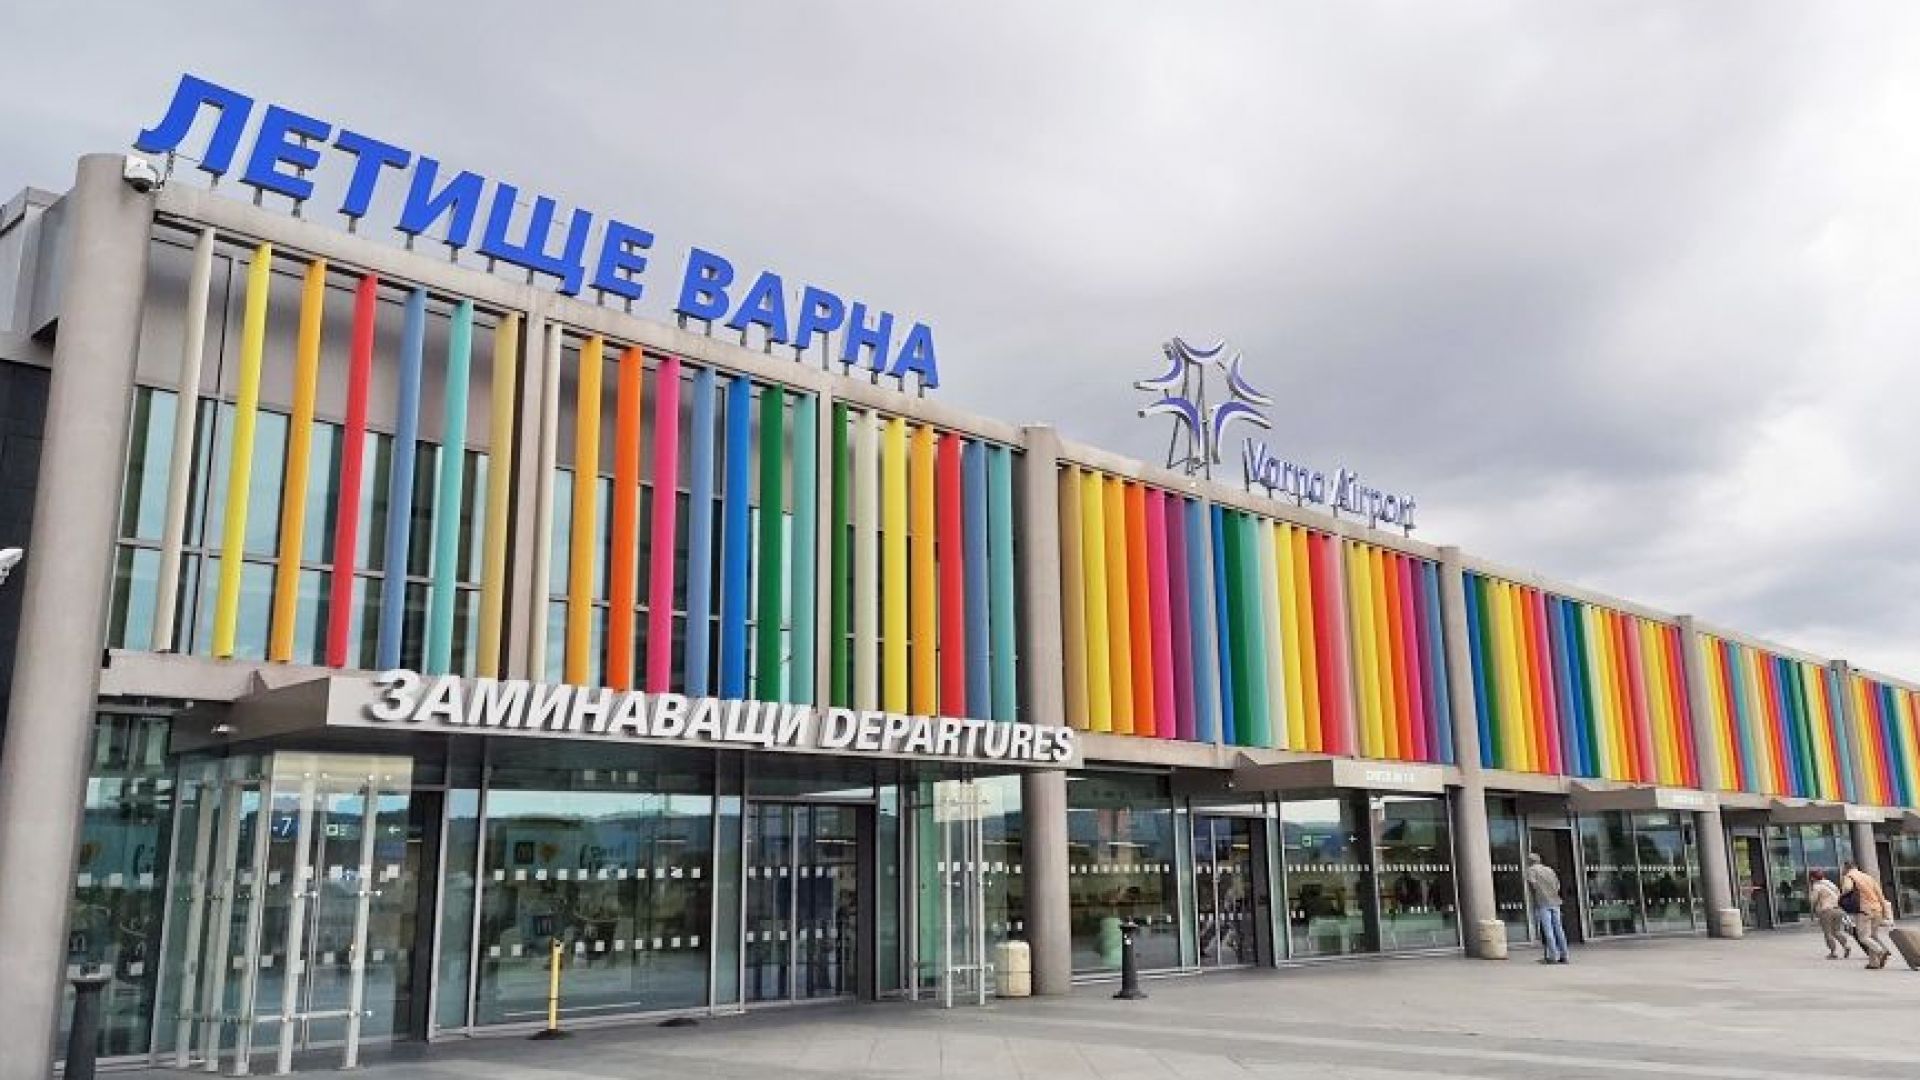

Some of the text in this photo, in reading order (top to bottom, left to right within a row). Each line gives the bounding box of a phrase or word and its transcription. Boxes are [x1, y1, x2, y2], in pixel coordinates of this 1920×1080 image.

[135, 73, 941, 389] ЛЕТИЩЕ ВАРНА
[1242, 437, 1416, 528] Varna Airport
[370, 669, 1075, 760] ЗАМИНАВАЩИ DEPARTURES
